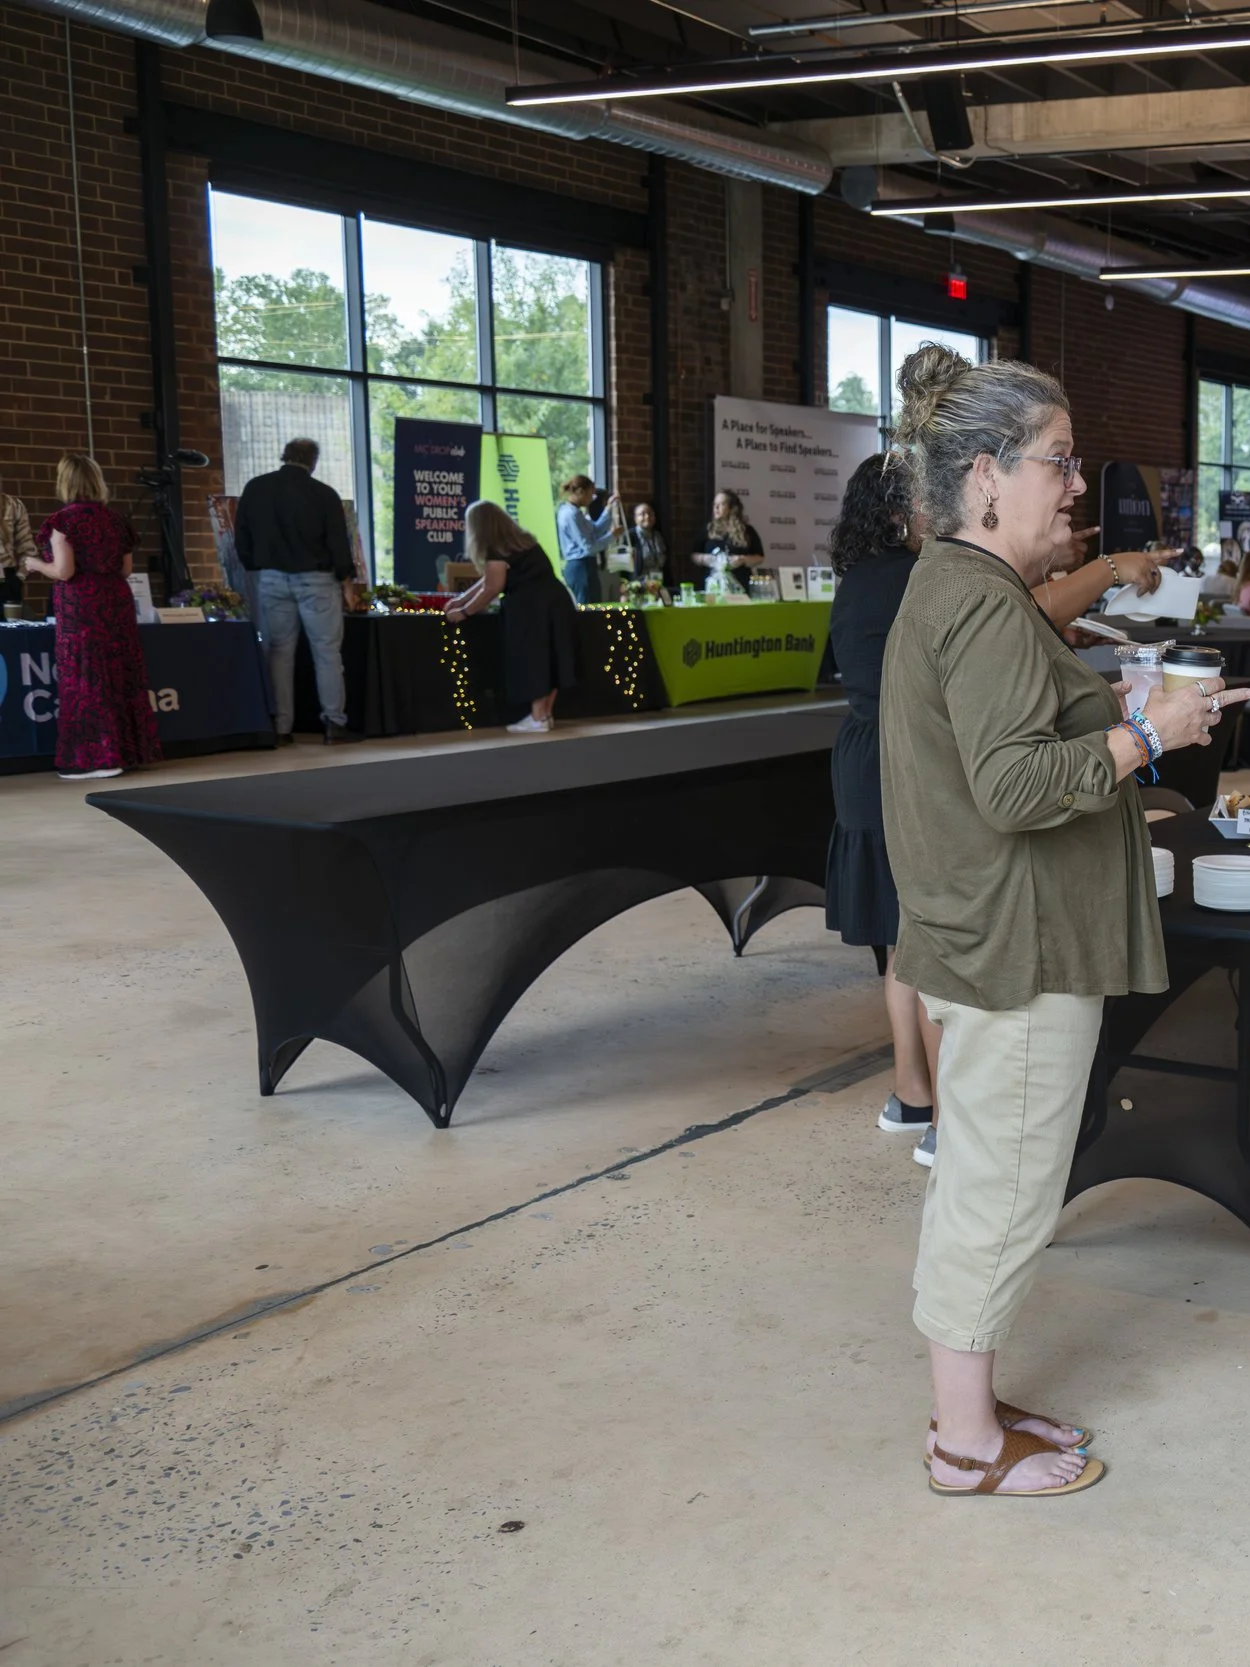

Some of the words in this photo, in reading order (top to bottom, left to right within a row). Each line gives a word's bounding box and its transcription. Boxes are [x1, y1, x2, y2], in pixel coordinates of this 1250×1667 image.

[722, 419, 729, 430] A
[730, 419, 754, 432] Place
[756, 422, 768, 434] for
[736, 438, 744, 448] A
[745, 438, 767, 451] Place
[769, 441, 778, 452] to
[780, 442, 798, 454] Find
[414, 470, 464, 484] WELCOME
[416, 484, 429, 493] TO
[432, 484, 462, 495] YOUR
[415, 495, 466, 507] WOMEN'S
[423, 508, 458, 518] PUBLIC
[416, 519, 466, 531] SPEAKING
[427, 532, 453, 542] CLUB
[705, 636, 782, 659] Huntington
[785, 633, 816, 653] Bank
